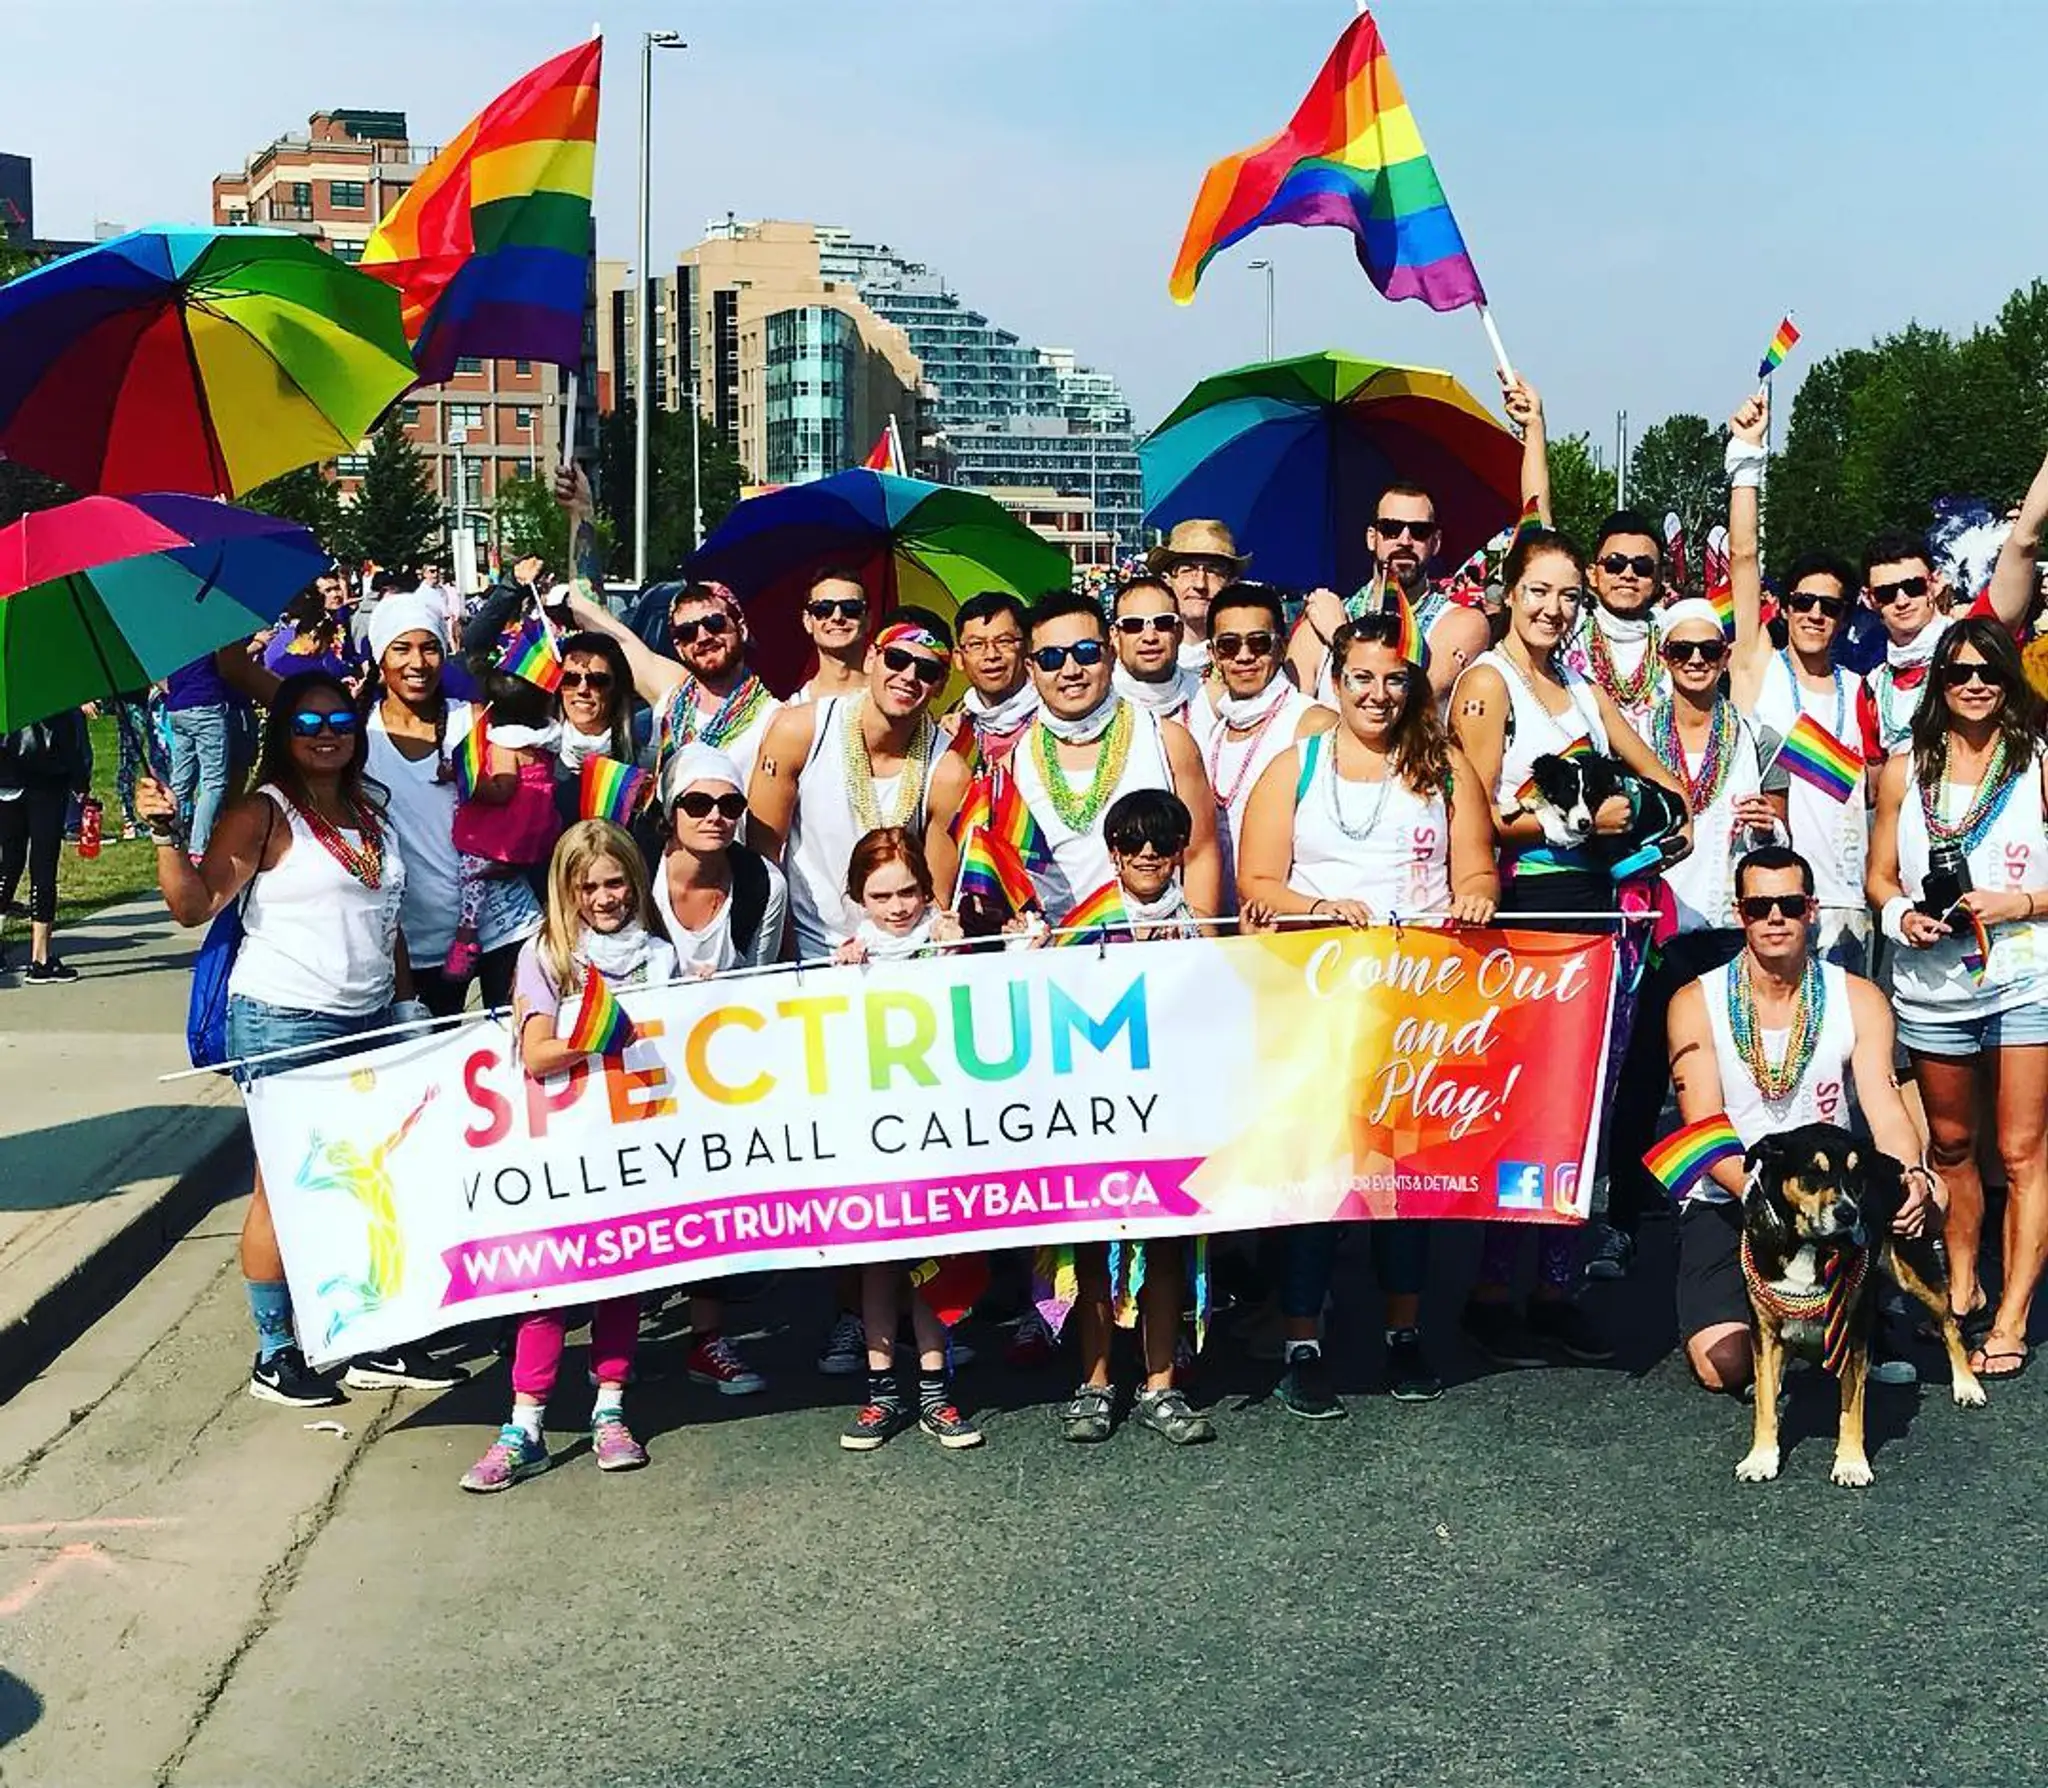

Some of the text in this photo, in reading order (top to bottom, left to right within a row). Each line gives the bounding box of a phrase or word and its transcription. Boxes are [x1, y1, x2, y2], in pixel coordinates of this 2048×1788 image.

[1304, 938, 1591, 1003] Come Out
[464, 971, 1150, 1149] SPECTRUM
[1393, 1004, 1500, 1056] and
[1370, 1060, 1523, 1140] Play!
[462, 1093, 1158, 1212] VOLLEYBALL CALGARY
[462, 1170, 1160, 1287] WWW.SPECTRUMVOLLEYBALL.CA
